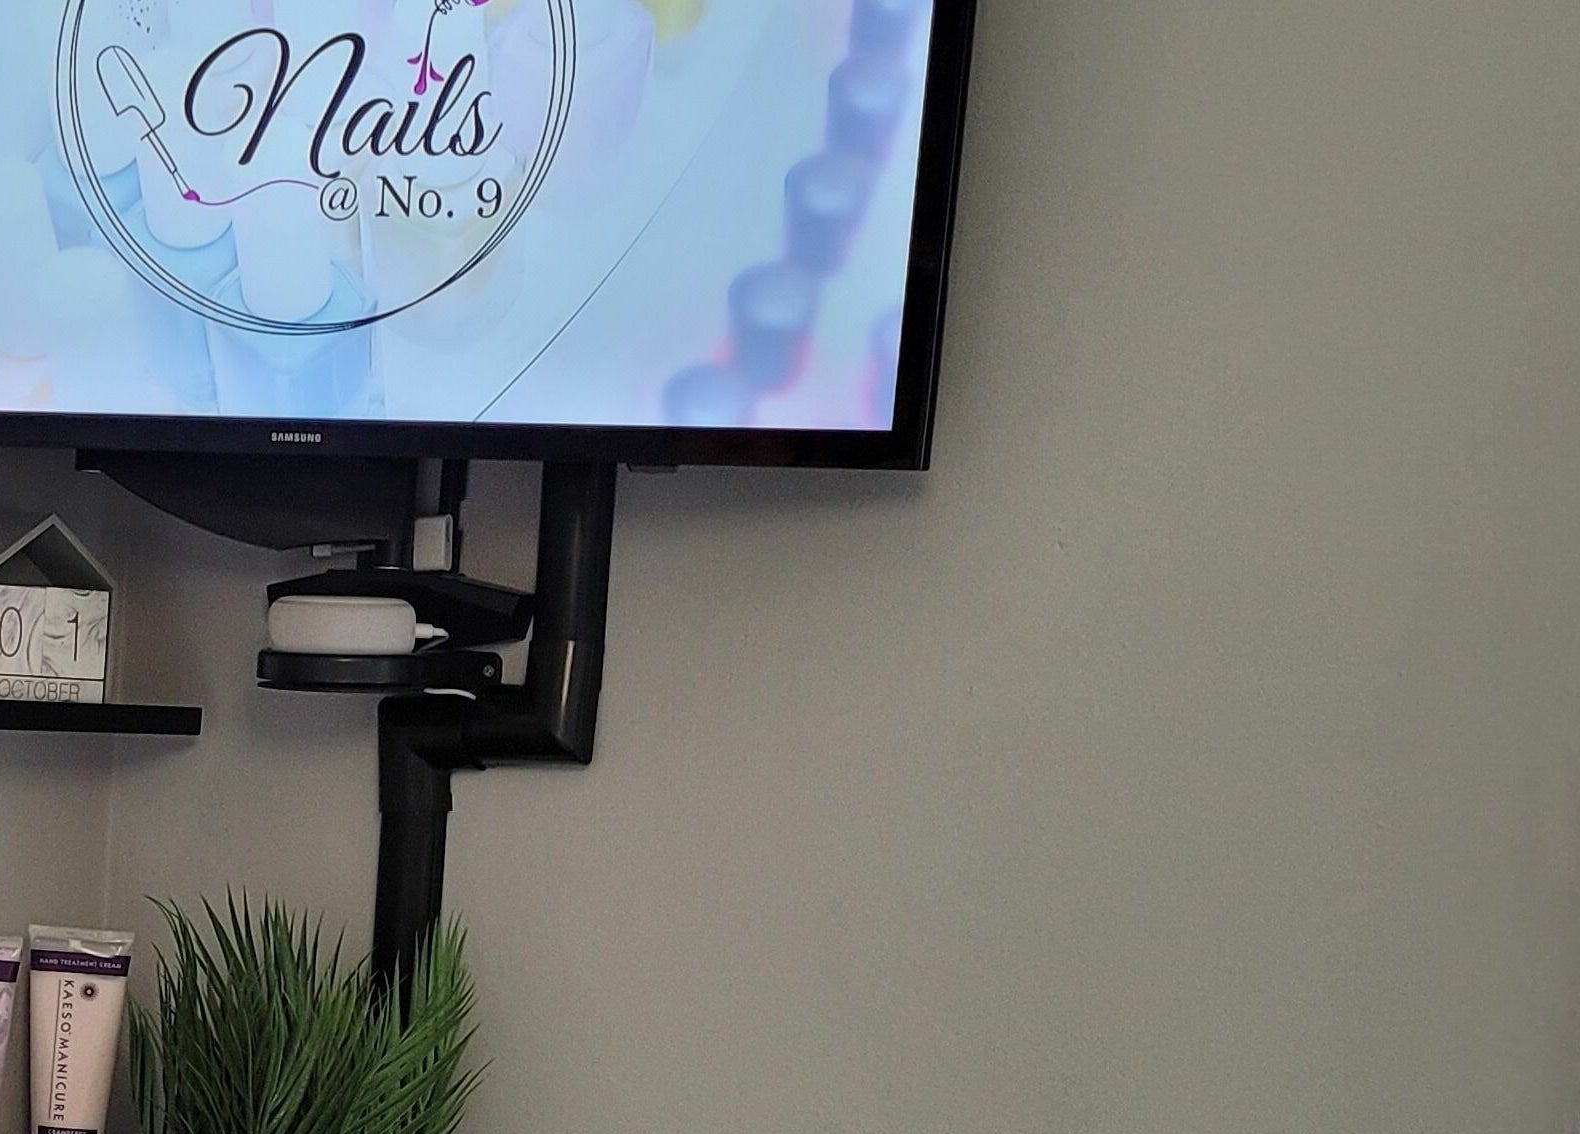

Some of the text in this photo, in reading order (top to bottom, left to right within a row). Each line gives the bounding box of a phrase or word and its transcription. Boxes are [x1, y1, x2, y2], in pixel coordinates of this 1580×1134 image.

[184, 28, 503, 178] Nails
[320, 176, 502, 221] @ No. 9
[271, 432, 322, 443] SAMSUNG
[40, 957, 122, 970] HAND TREATMENT CREAM
[53, 1036, 69, 1121] MANICURE
